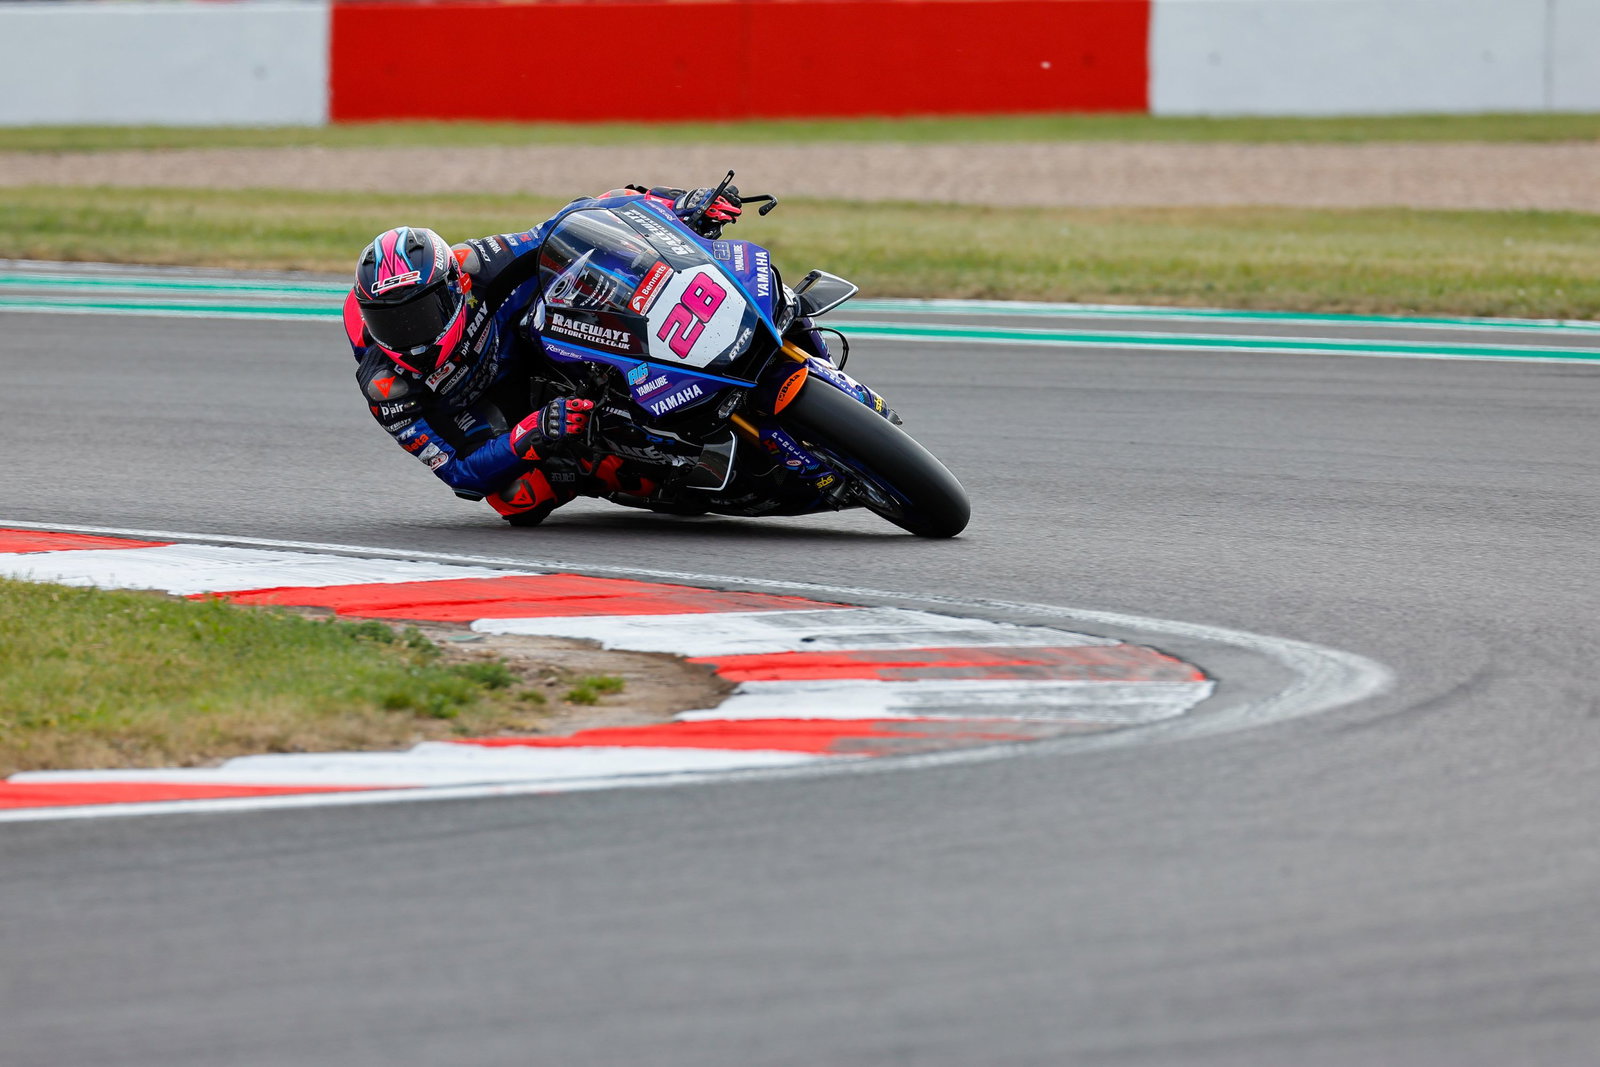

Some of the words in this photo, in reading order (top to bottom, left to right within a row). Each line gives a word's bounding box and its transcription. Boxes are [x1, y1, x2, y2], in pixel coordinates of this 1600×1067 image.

[713, 241, 731, 260] 28
[733, 244, 745, 272] YAMALUBE
[371, 271, 422, 294] LS2
[642, 264, 667, 296] Bennetts
[755, 251, 770, 297] YAMAHA
[467, 301, 490, 337] RAY
[552, 313, 631, 343] RACEWAYS
[656, 271, 728, 360] 28
[550, 325, 631, 351] MOTORCYCLES.CO.UK
[636, 374, 669, 397] YAMALUBE
[781, 373, 801, 395] Beta
[651, 384, 703, 417] YAMAHA
[771, 431, 811, 464] PIRELLI
[816, 474, 834, 489] sbs
